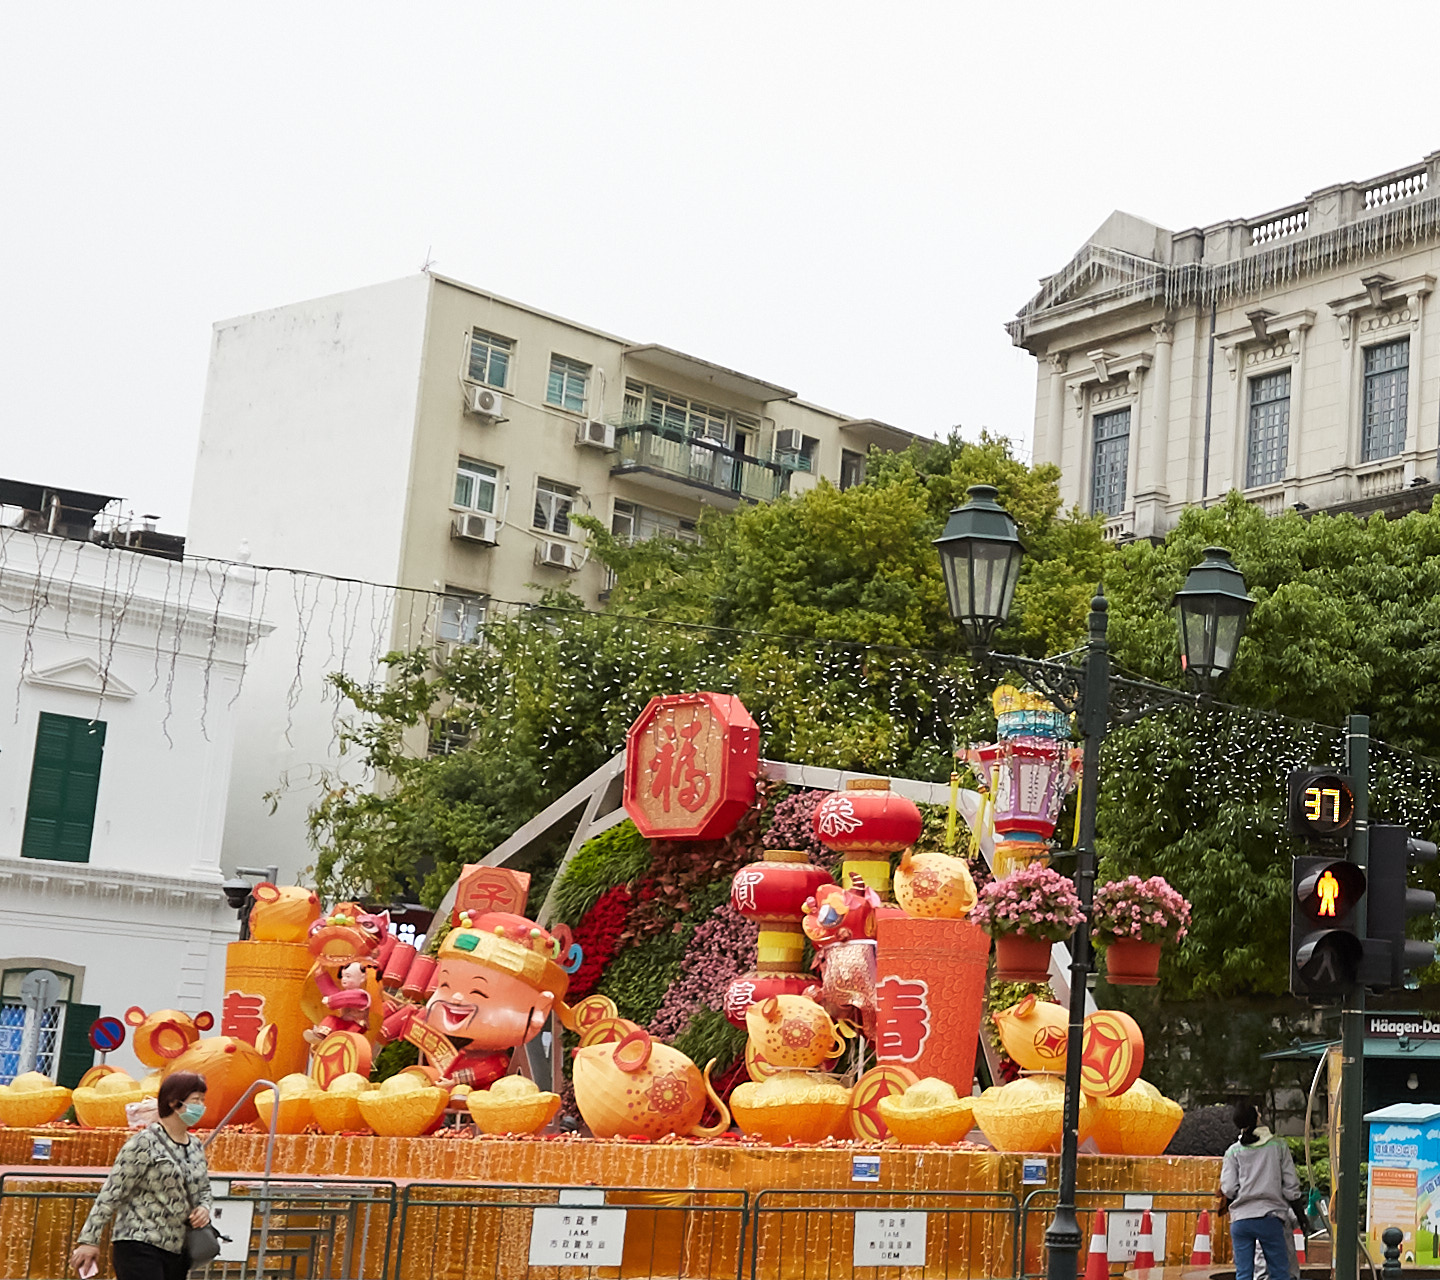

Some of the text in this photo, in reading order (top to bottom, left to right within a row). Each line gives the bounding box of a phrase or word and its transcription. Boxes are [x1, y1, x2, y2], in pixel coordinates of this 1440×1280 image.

[818, 797, 863, 837] 恭
[1305, 787, 1340, 823] 37
[565, 1251, 589, 1260] DEM
